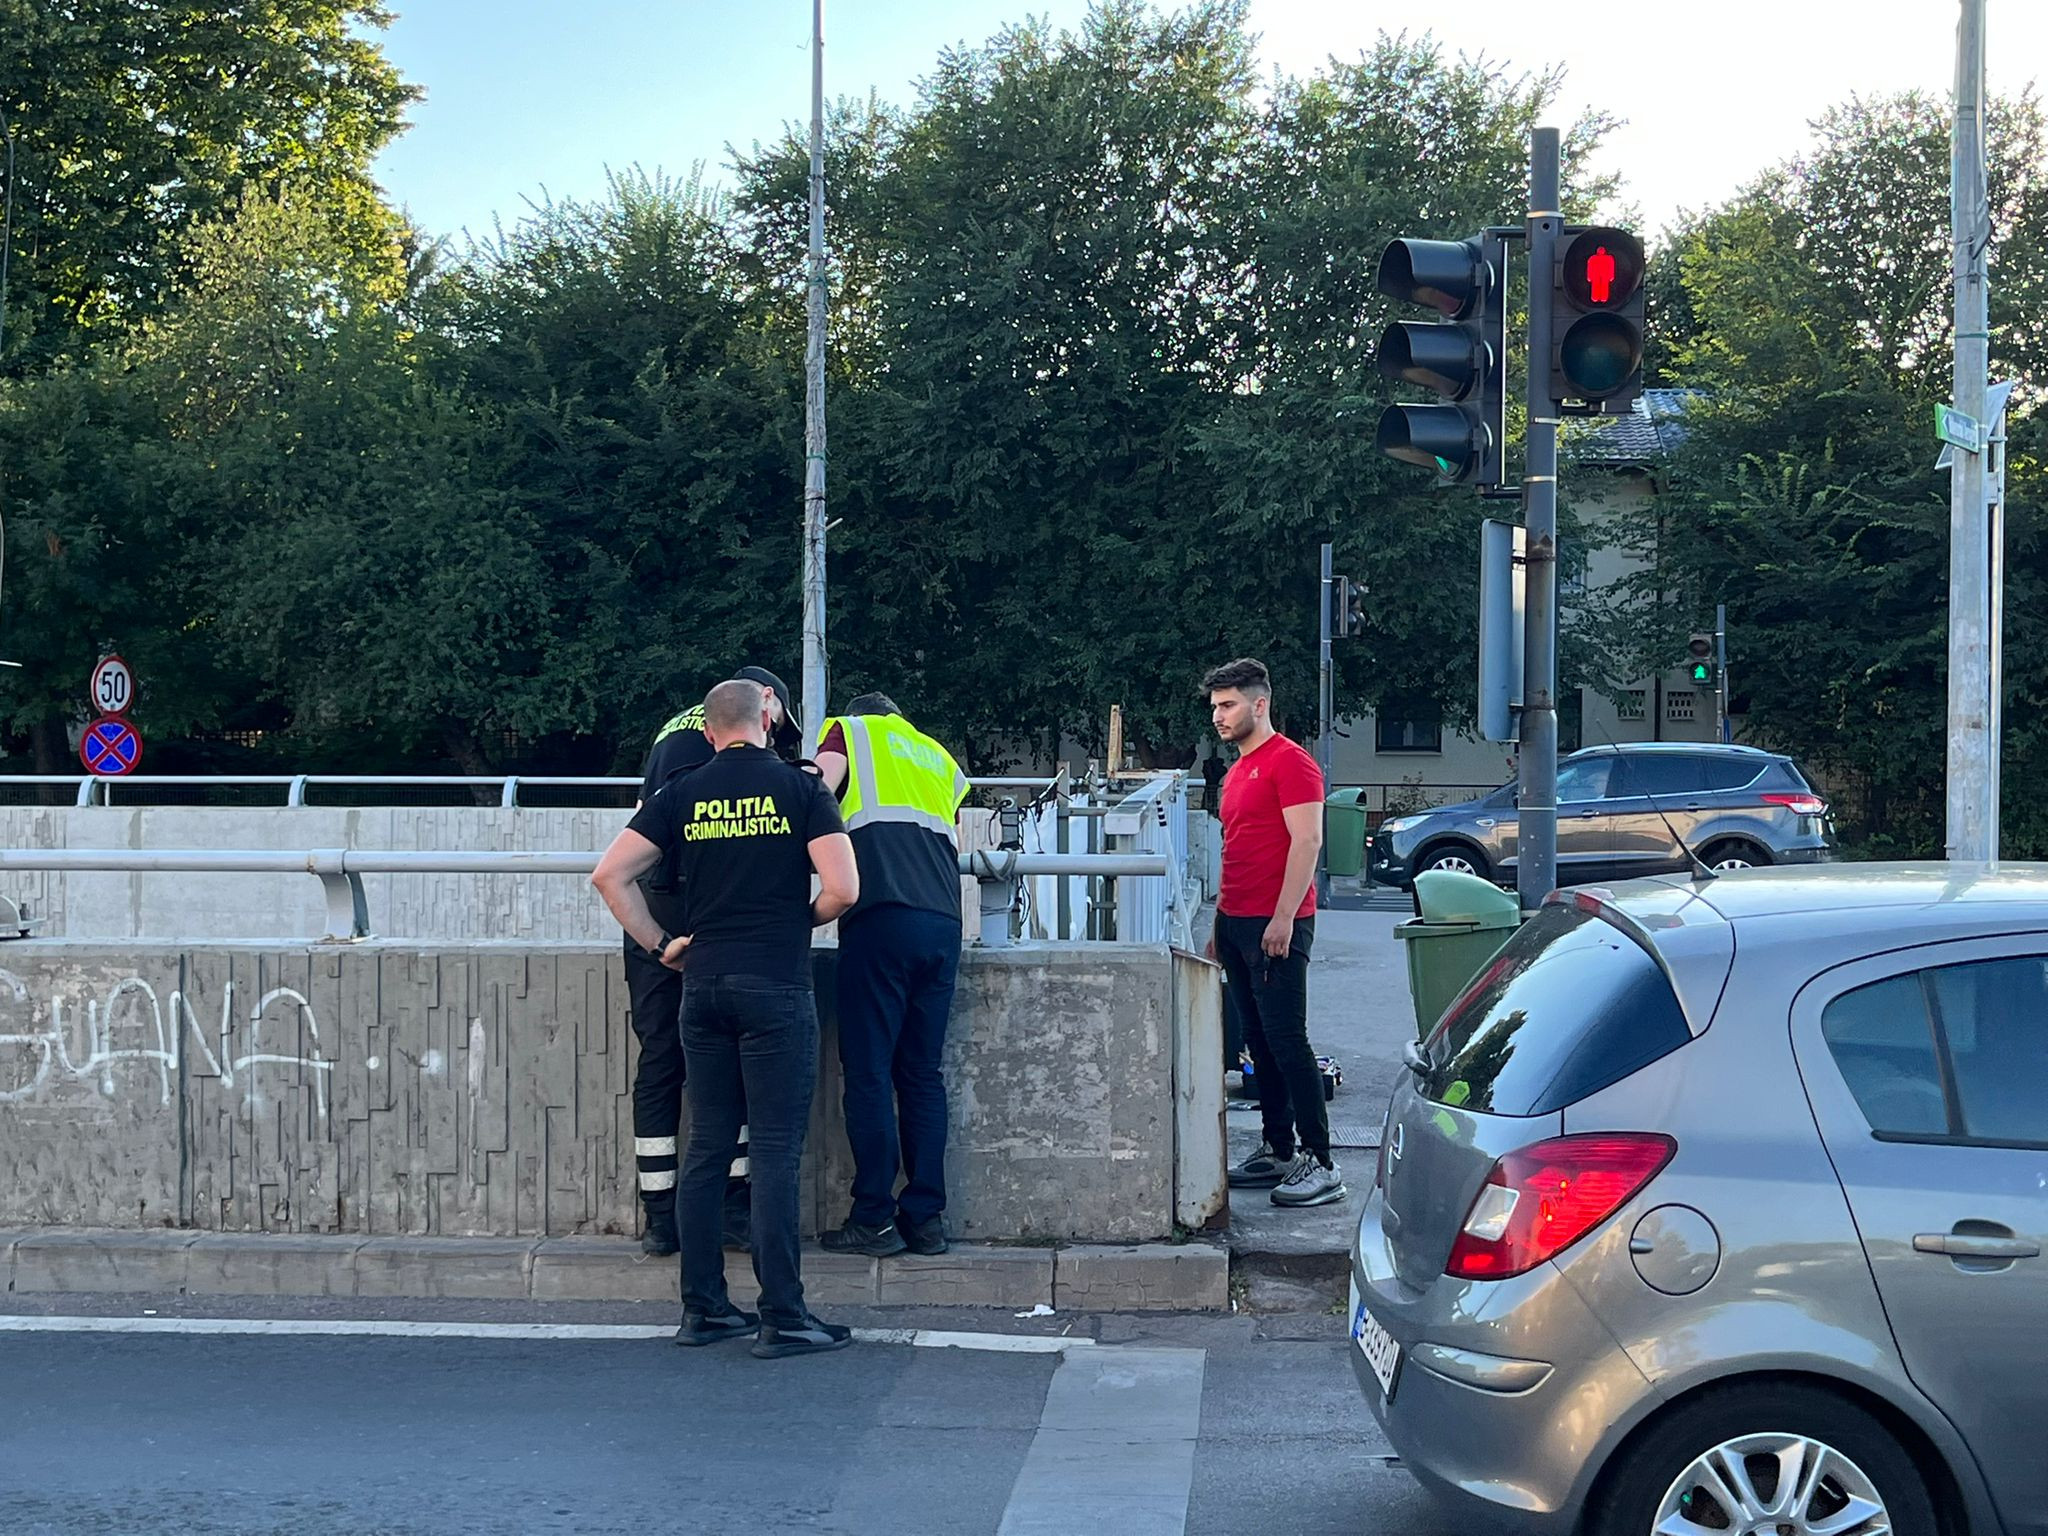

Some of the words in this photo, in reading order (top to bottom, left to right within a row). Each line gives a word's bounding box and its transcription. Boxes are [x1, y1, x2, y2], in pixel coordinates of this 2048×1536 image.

[101, 671, 125, 703] 50
[693, 796, 777, 821] POLITIA
[684, 816, 791, 842] CRIMINALISTICA
